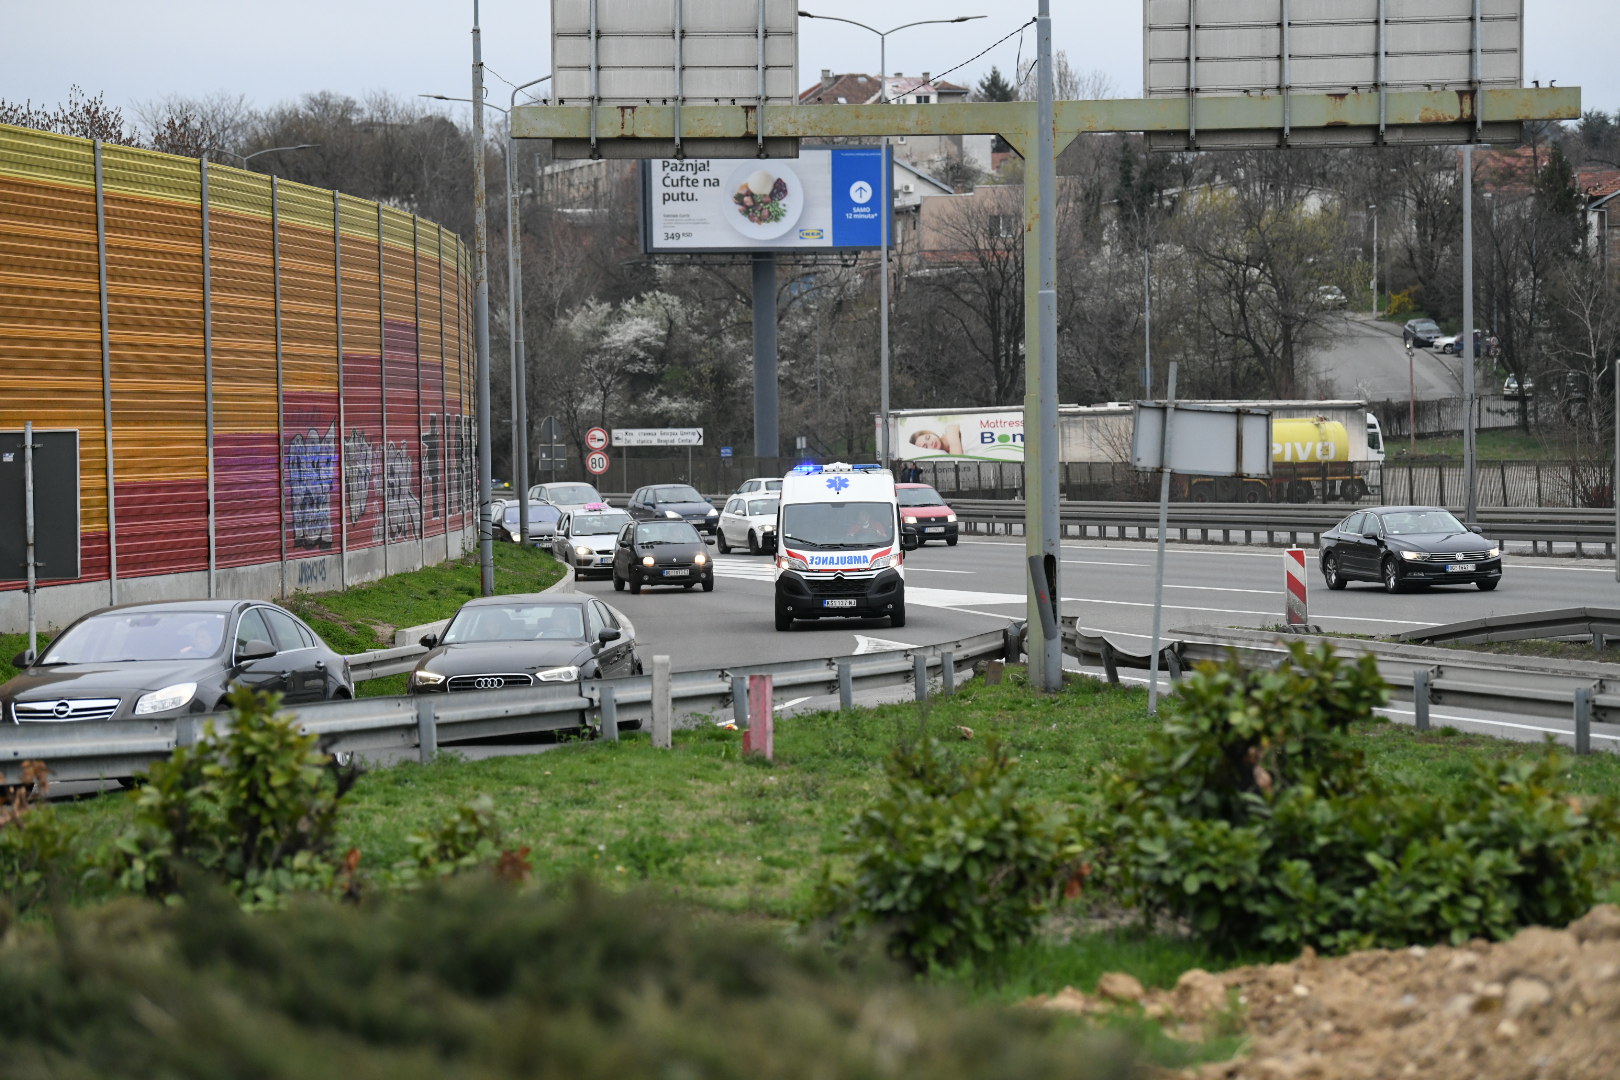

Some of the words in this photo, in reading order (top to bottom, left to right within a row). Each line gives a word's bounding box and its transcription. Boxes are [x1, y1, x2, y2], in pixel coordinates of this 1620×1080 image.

[662, 160, 710, 175] Pažnja!
[662, 172, 699, 188] Ćufte
[703, 177, 720, 187] na
[662, 191, 698, 205] putu.
[663, 232, 681, 241] 349
[590, 457, 604, 469] 80
